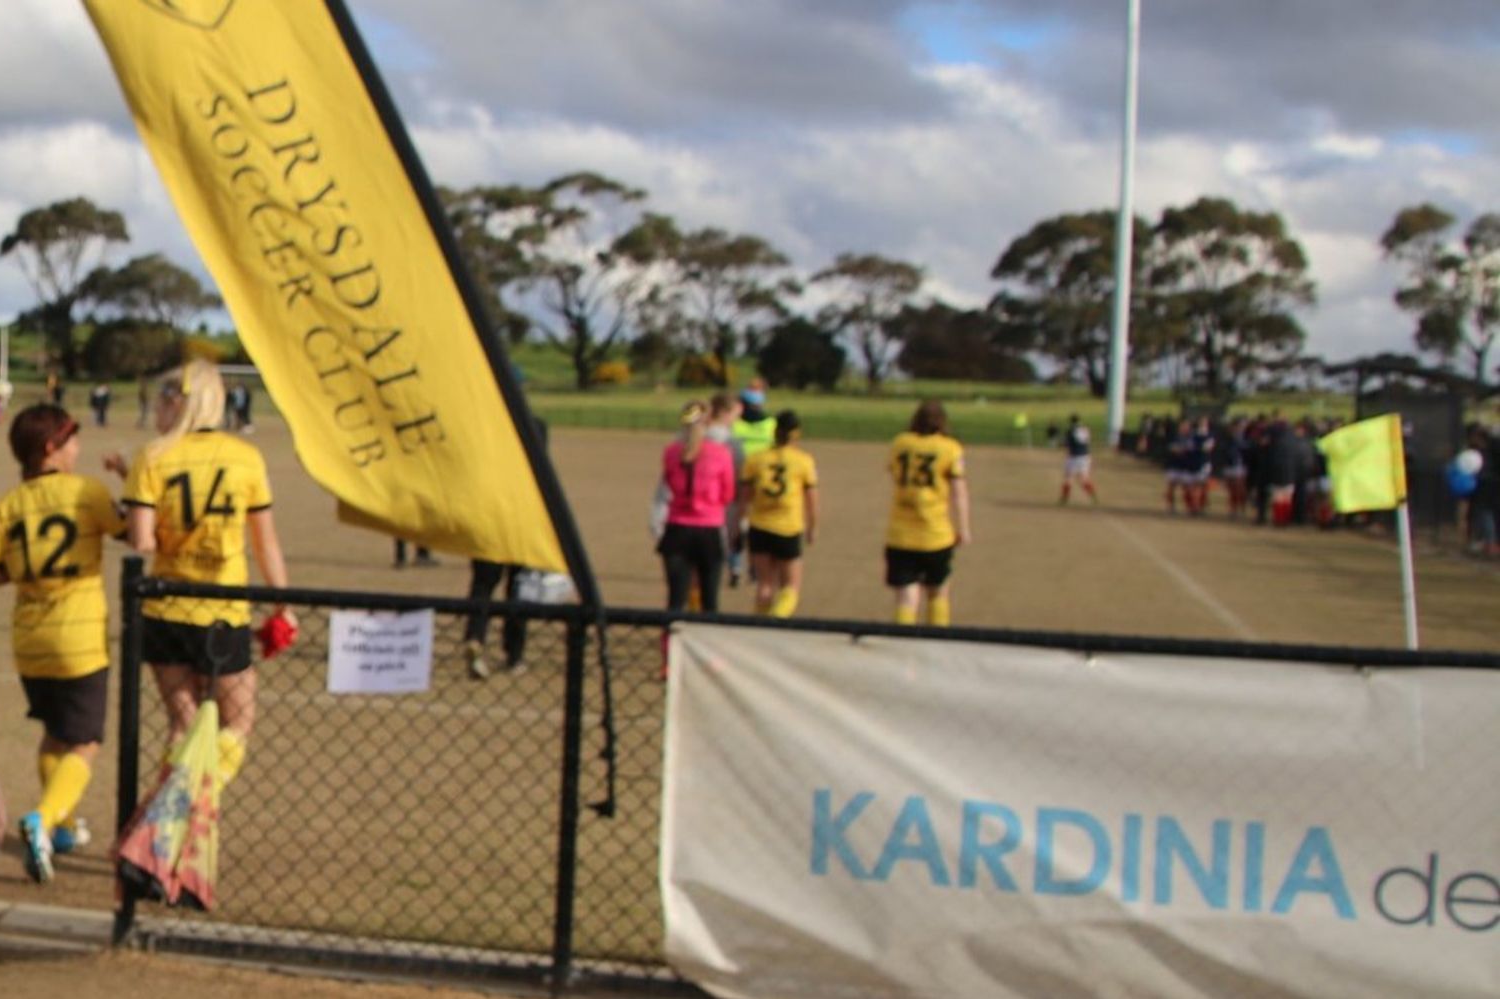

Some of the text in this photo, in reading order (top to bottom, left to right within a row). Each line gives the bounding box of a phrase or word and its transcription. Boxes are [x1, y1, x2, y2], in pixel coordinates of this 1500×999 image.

[200, 93, 386, 468] SOCCER CLUB
[247, 79, 447, 456] DRYSDALE
[165, 466, 237, 532] 14
[763, 463, 788, 498] 3
[896, 451, 937, 488] 13
[9, 513, 80, 584] 12
[809, 788, 1500, 932] KARDINIA de
